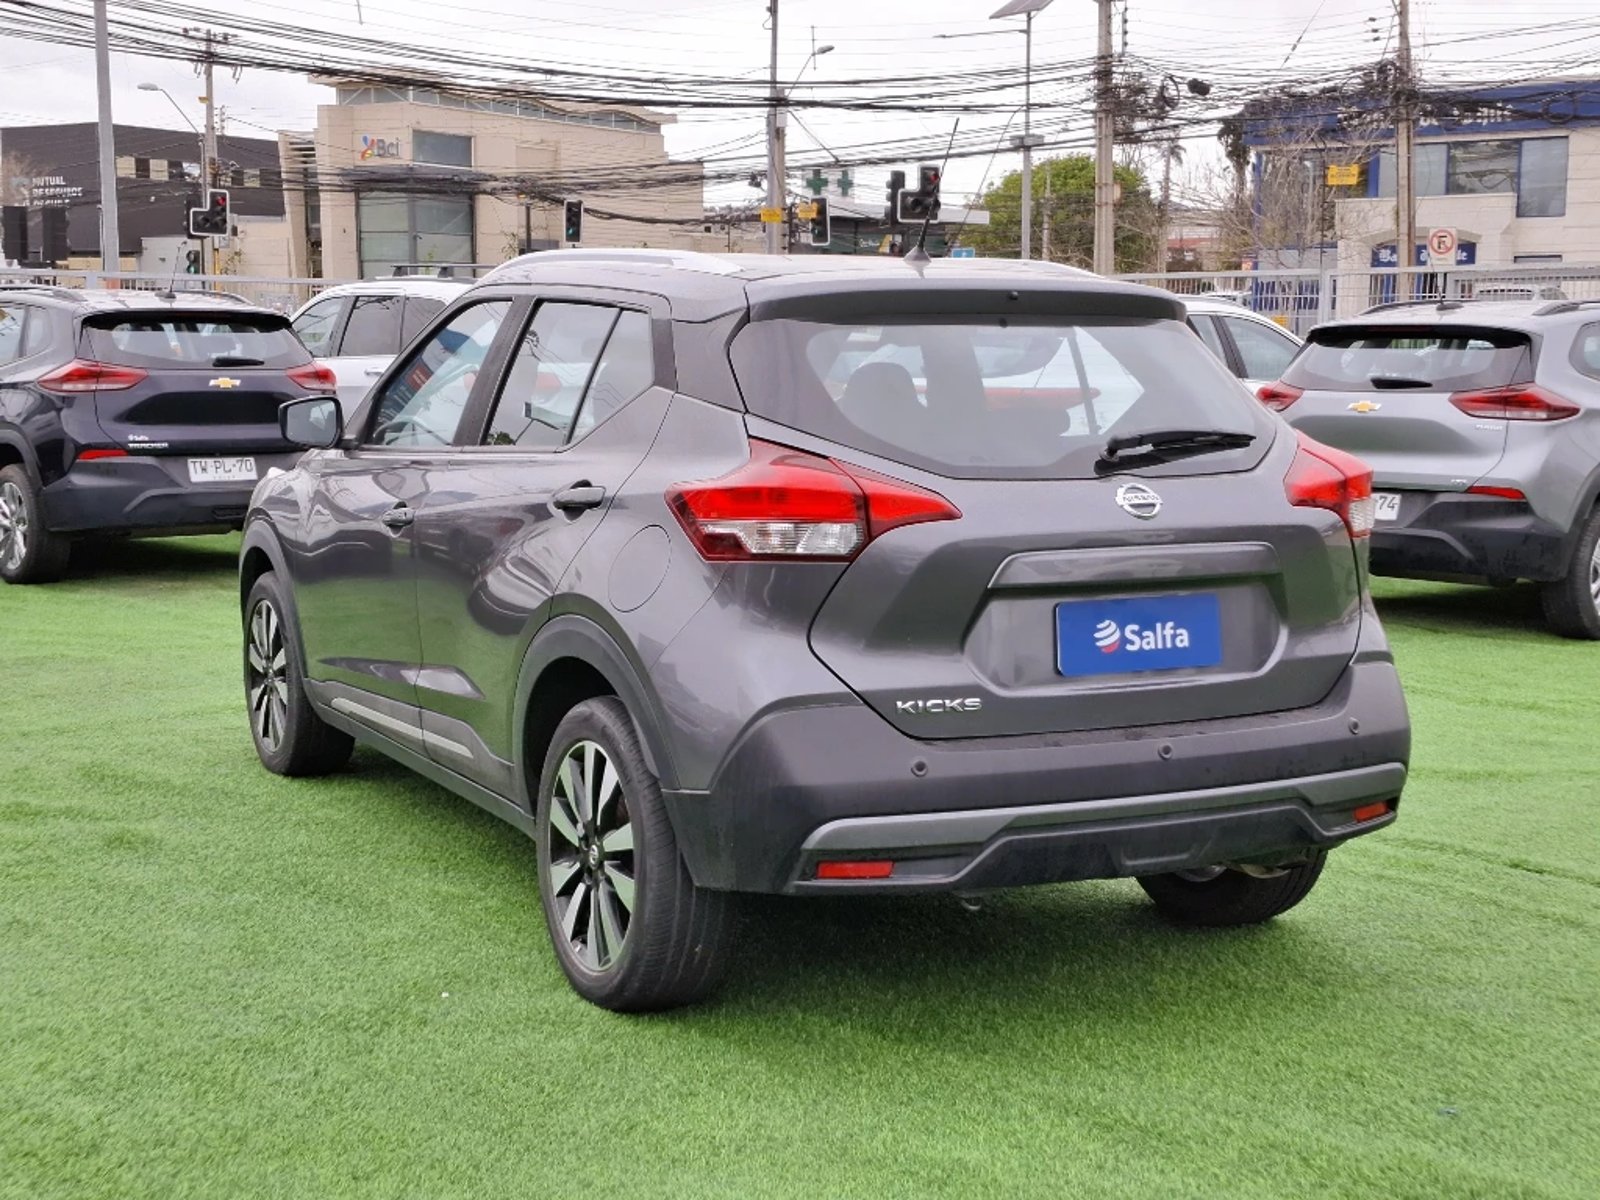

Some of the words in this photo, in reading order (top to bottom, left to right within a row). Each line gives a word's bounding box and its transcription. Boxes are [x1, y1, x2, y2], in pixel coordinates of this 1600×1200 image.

[376, 137, 399, 157] Bci
[1124, 621, 1190, 651] Salfa
[896, 697, 982, 714] KICKS
